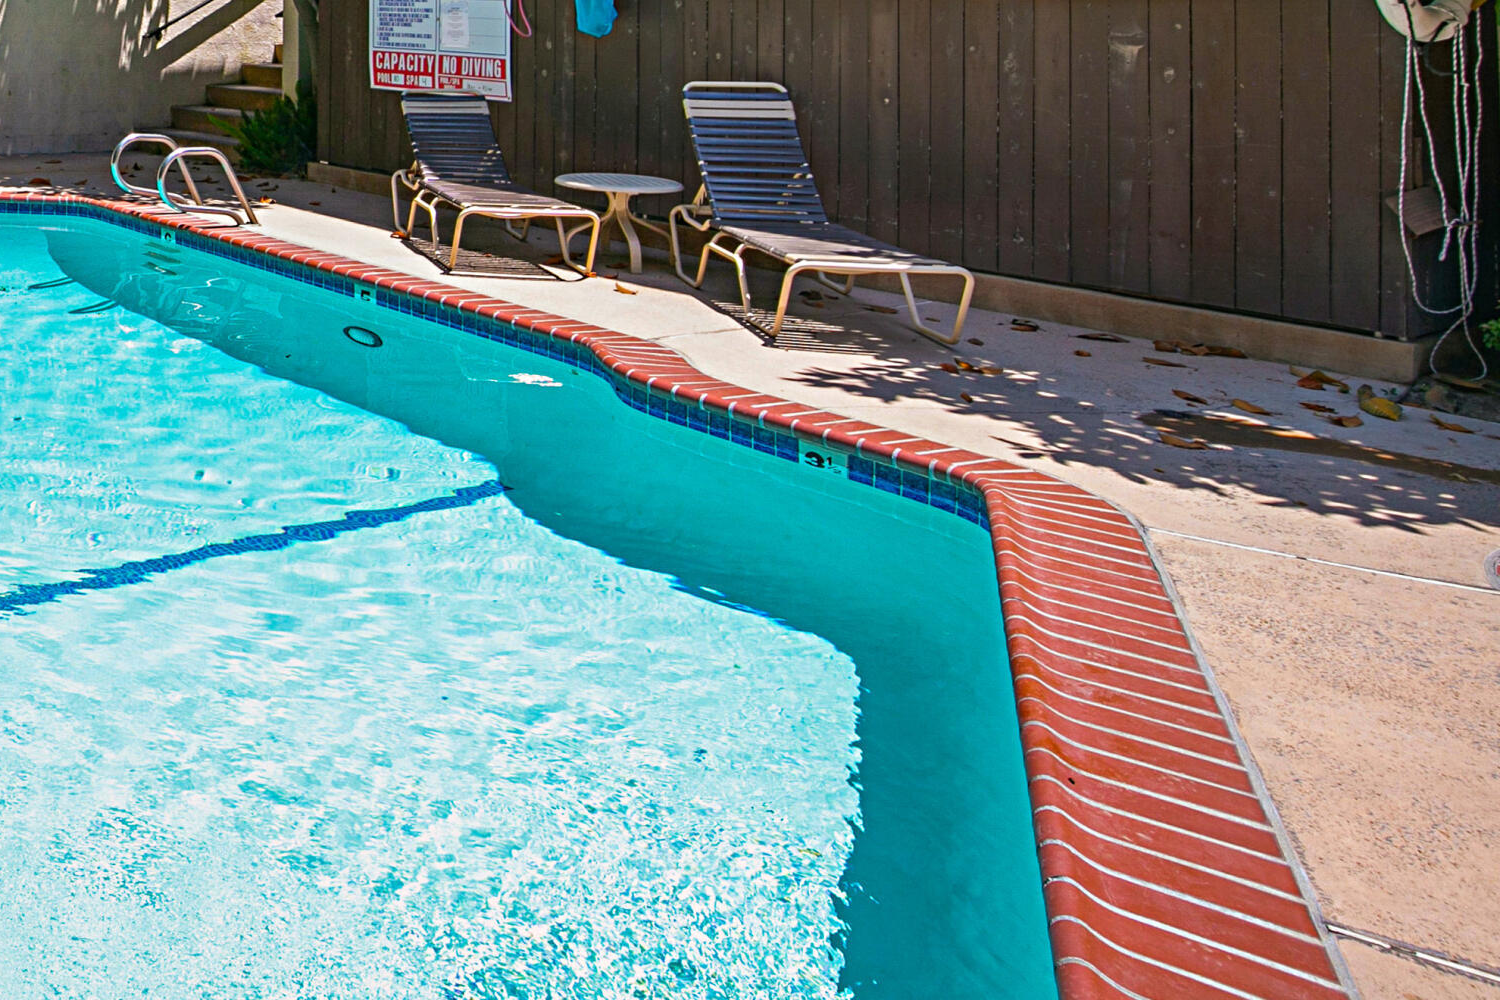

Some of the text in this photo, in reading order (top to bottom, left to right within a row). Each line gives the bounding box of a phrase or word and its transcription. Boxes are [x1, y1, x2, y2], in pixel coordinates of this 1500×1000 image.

[376, 52, 434, 73] CAPACITY
[442, 56, 502, 78] NO DIVING
